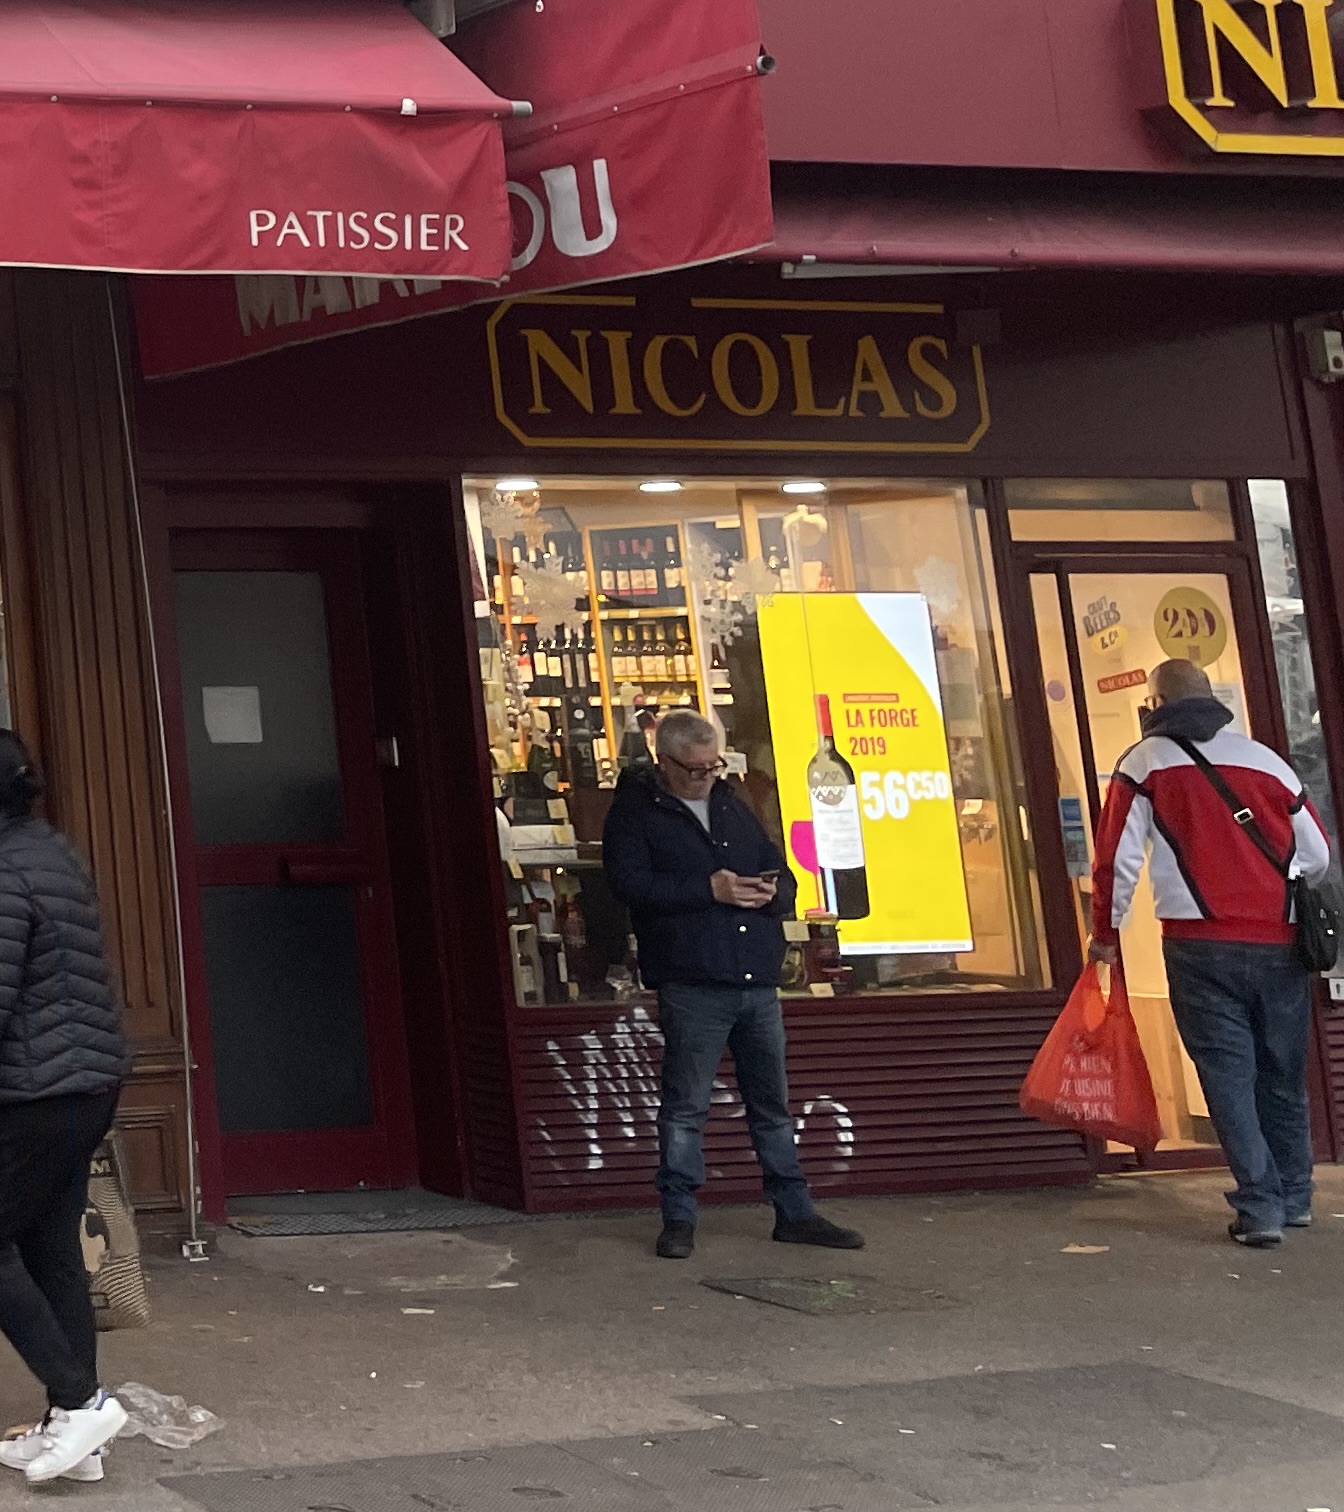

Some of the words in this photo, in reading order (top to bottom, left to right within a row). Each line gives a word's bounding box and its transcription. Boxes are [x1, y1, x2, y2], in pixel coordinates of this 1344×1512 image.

[247, 208, 470, 252] PATISSIER
[520, 327, 958, 420] NICOLAS
[845, 709, 865, 728] LA
[869, 708, 920, 728] FORGE
[849, 736, 887, 756] 2019
